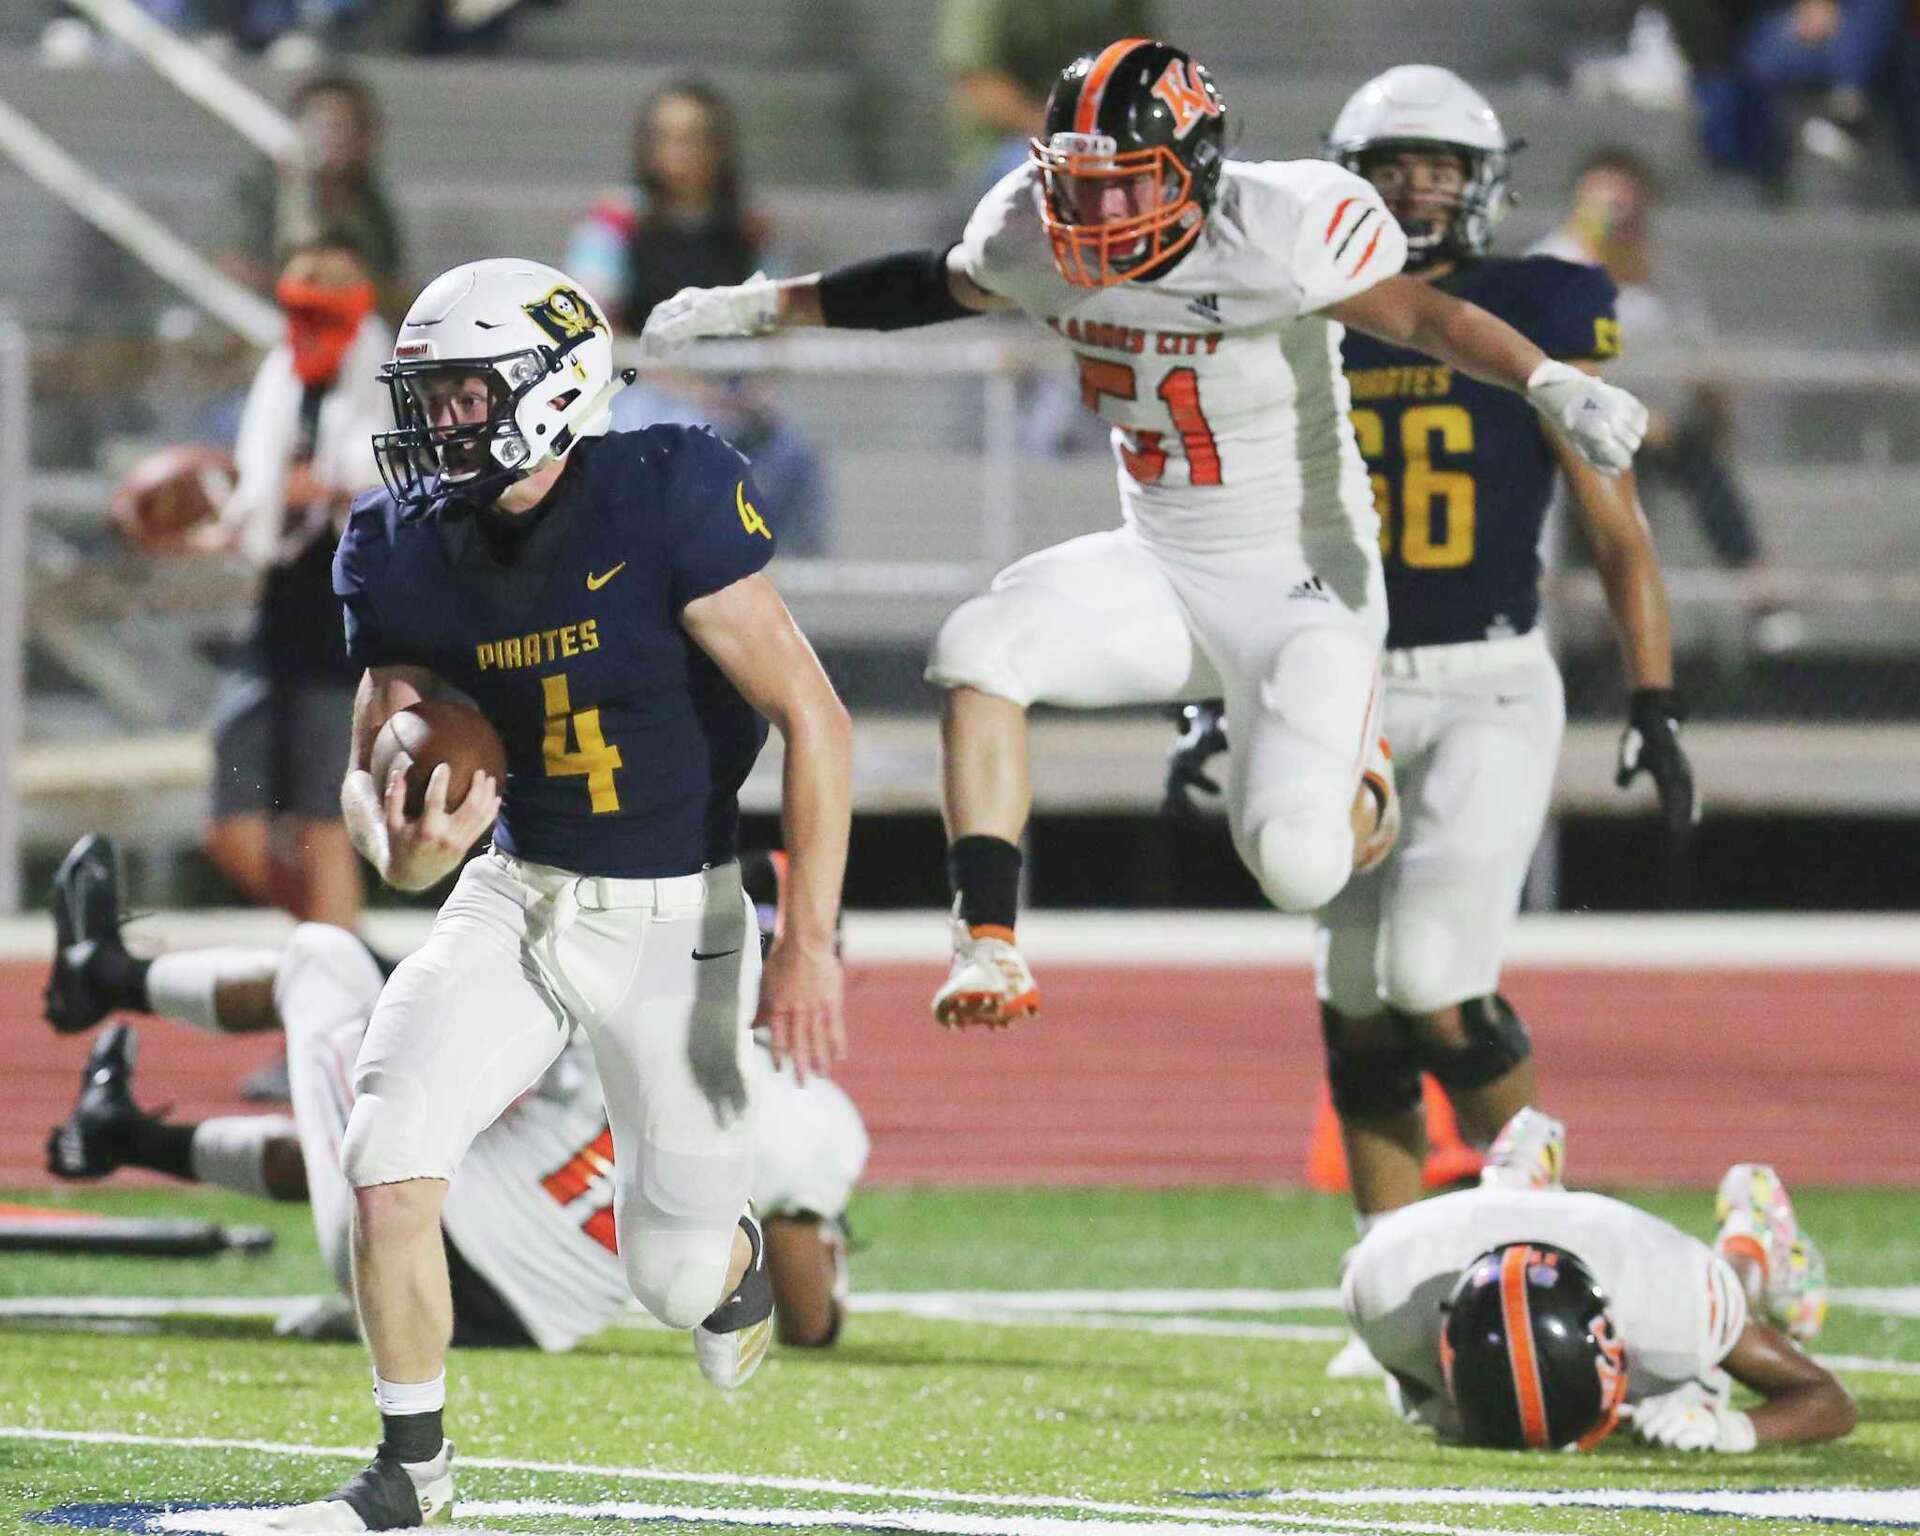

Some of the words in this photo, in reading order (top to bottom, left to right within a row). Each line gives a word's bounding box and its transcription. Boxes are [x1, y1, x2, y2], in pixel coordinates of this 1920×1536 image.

[736, 480, 772, 540] 4
[477, 618, 600, 671] PIRATES
[541, 672, 623, 814] 4
